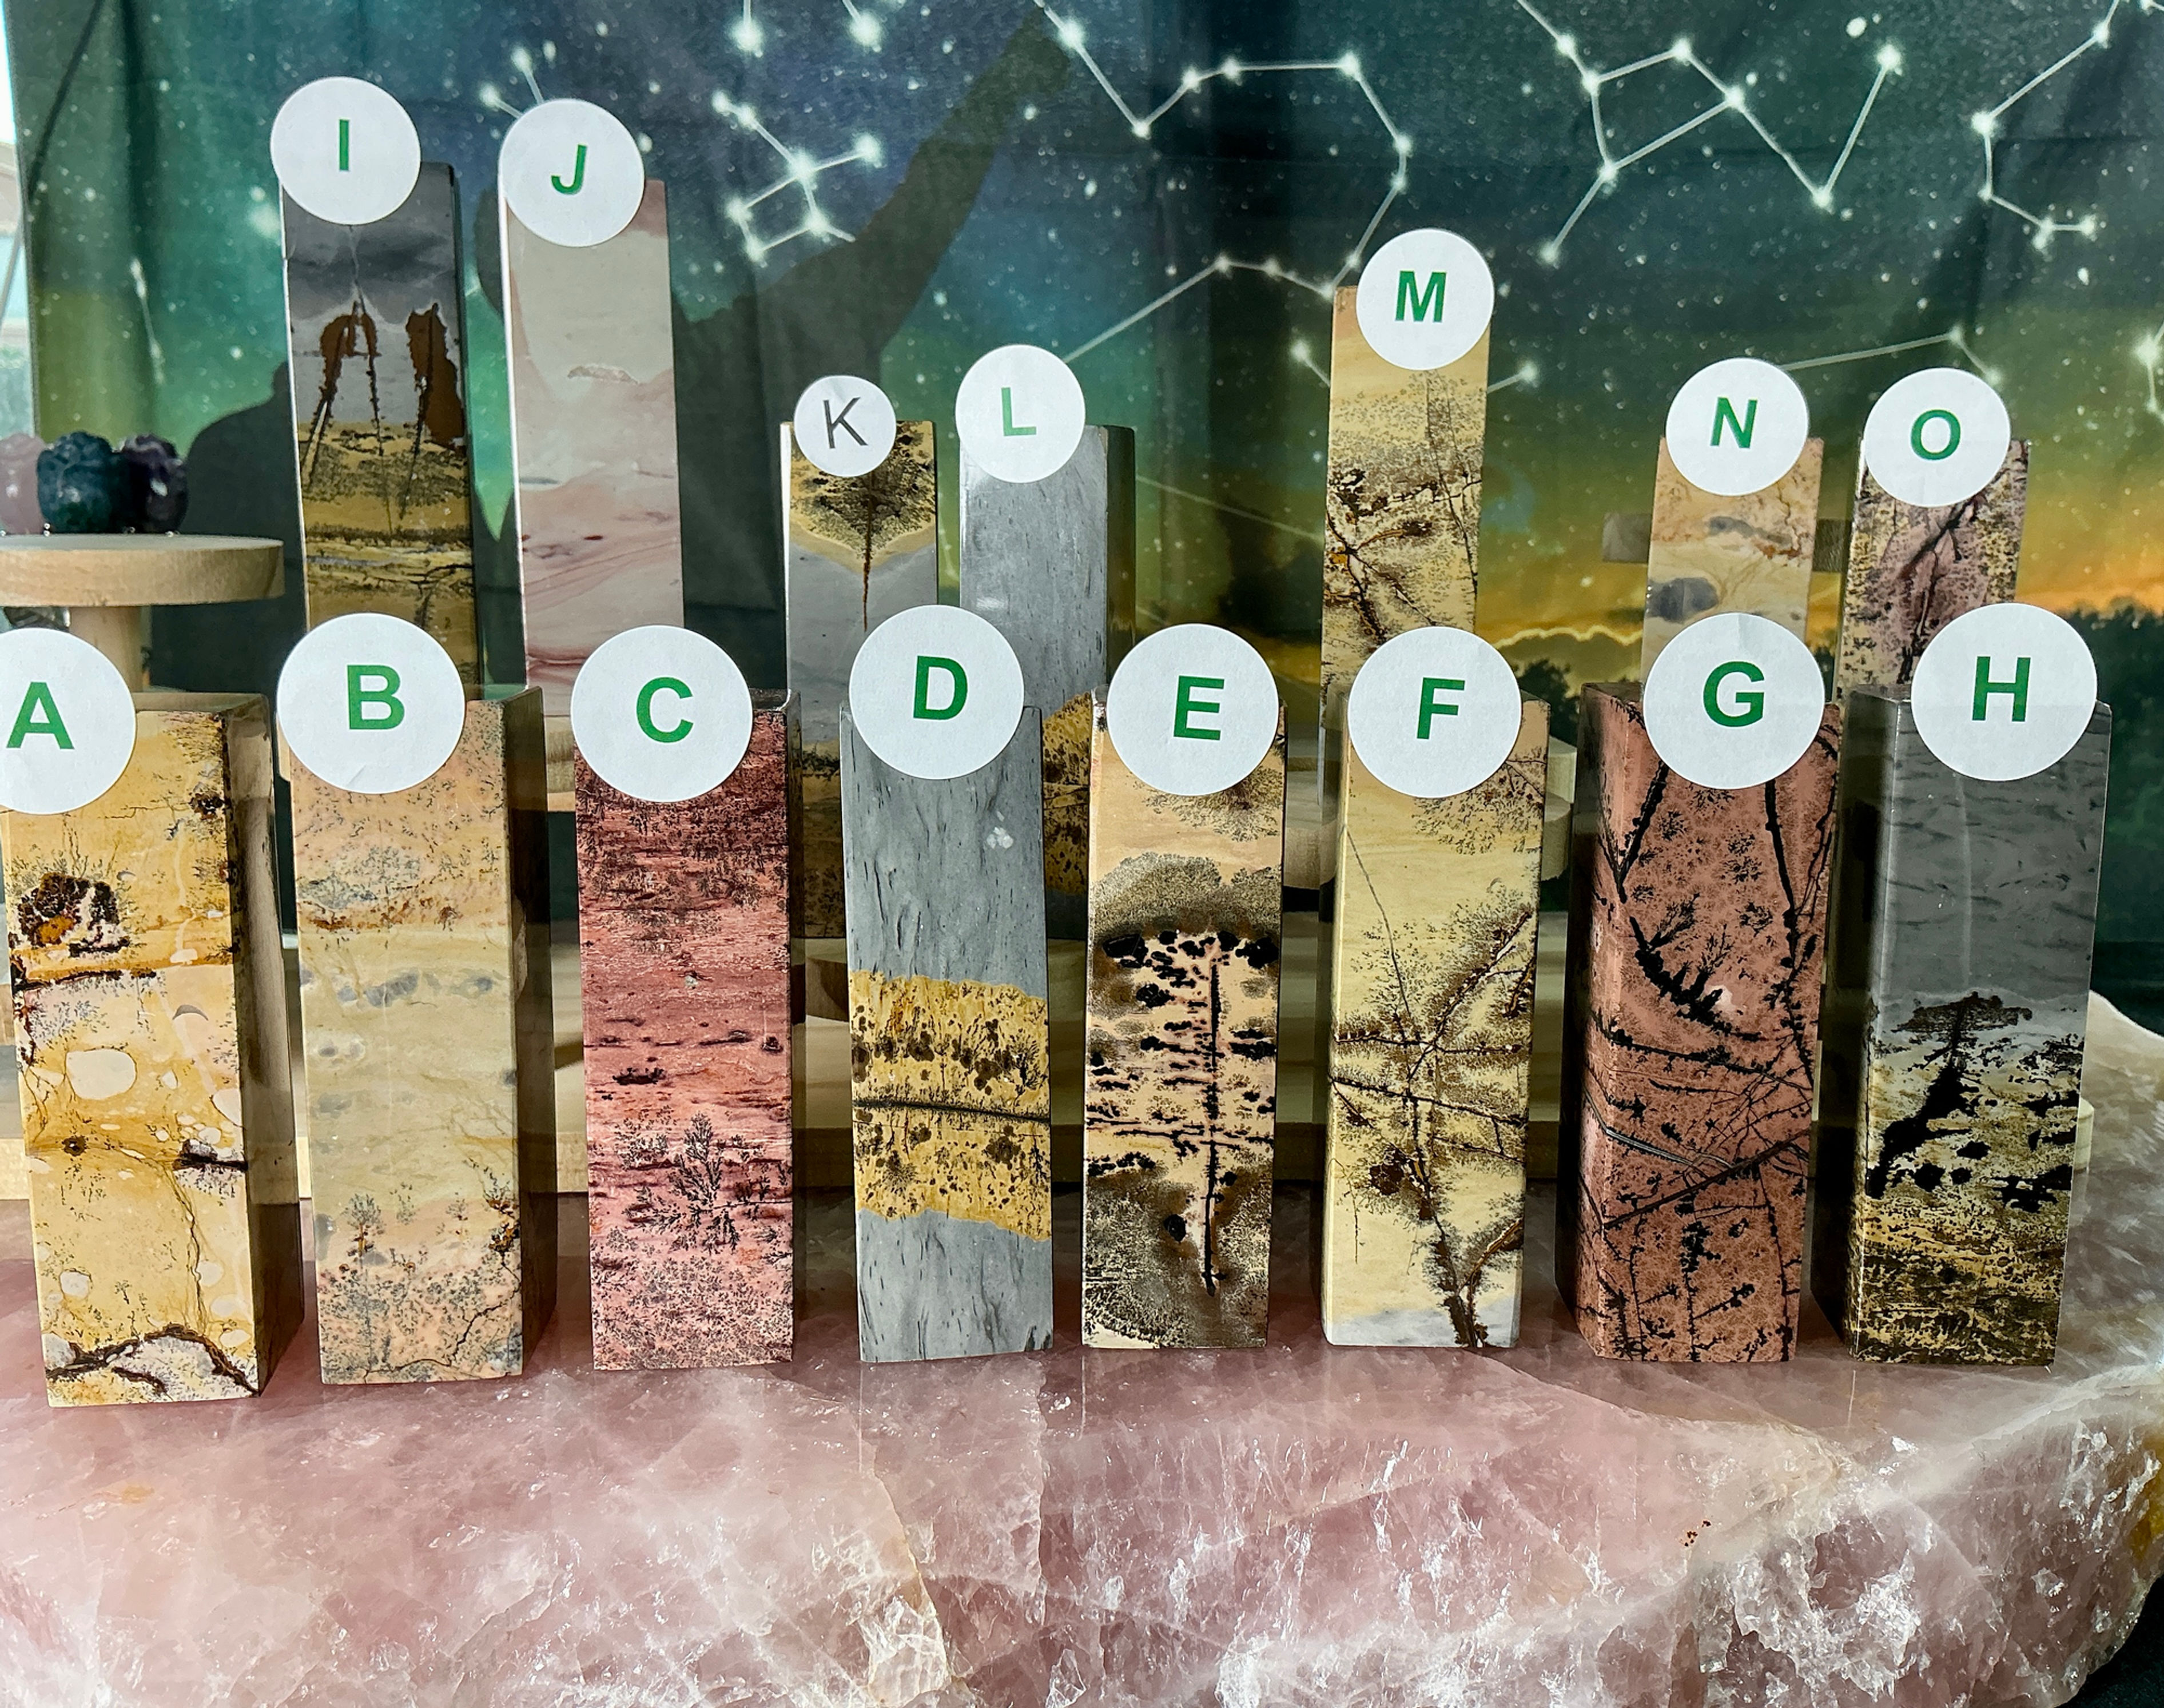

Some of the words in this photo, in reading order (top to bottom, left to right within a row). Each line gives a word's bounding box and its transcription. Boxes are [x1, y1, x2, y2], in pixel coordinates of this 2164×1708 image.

[339, 120, 349, 171] I
[551, 145, 587, 195] J
[1395, 271, 1446, 322] M
[824, 397, 868, 449] K
[1003, 388, 1036, 436] L
[1711, 397, 1757, 448] N
[1911, 409, 1961, 461] O
[6, 682, 74, 749] A
[348, 665, 405, 730] B
[636, 676, 694, 743] C
[913, 656, 968, 720] D
[1174, 676, 1224, 740] E
[1417, 678, 1466, 739] F
[1702, 662, 1765, 727] G
[1972, 656, 2031, 722] H
